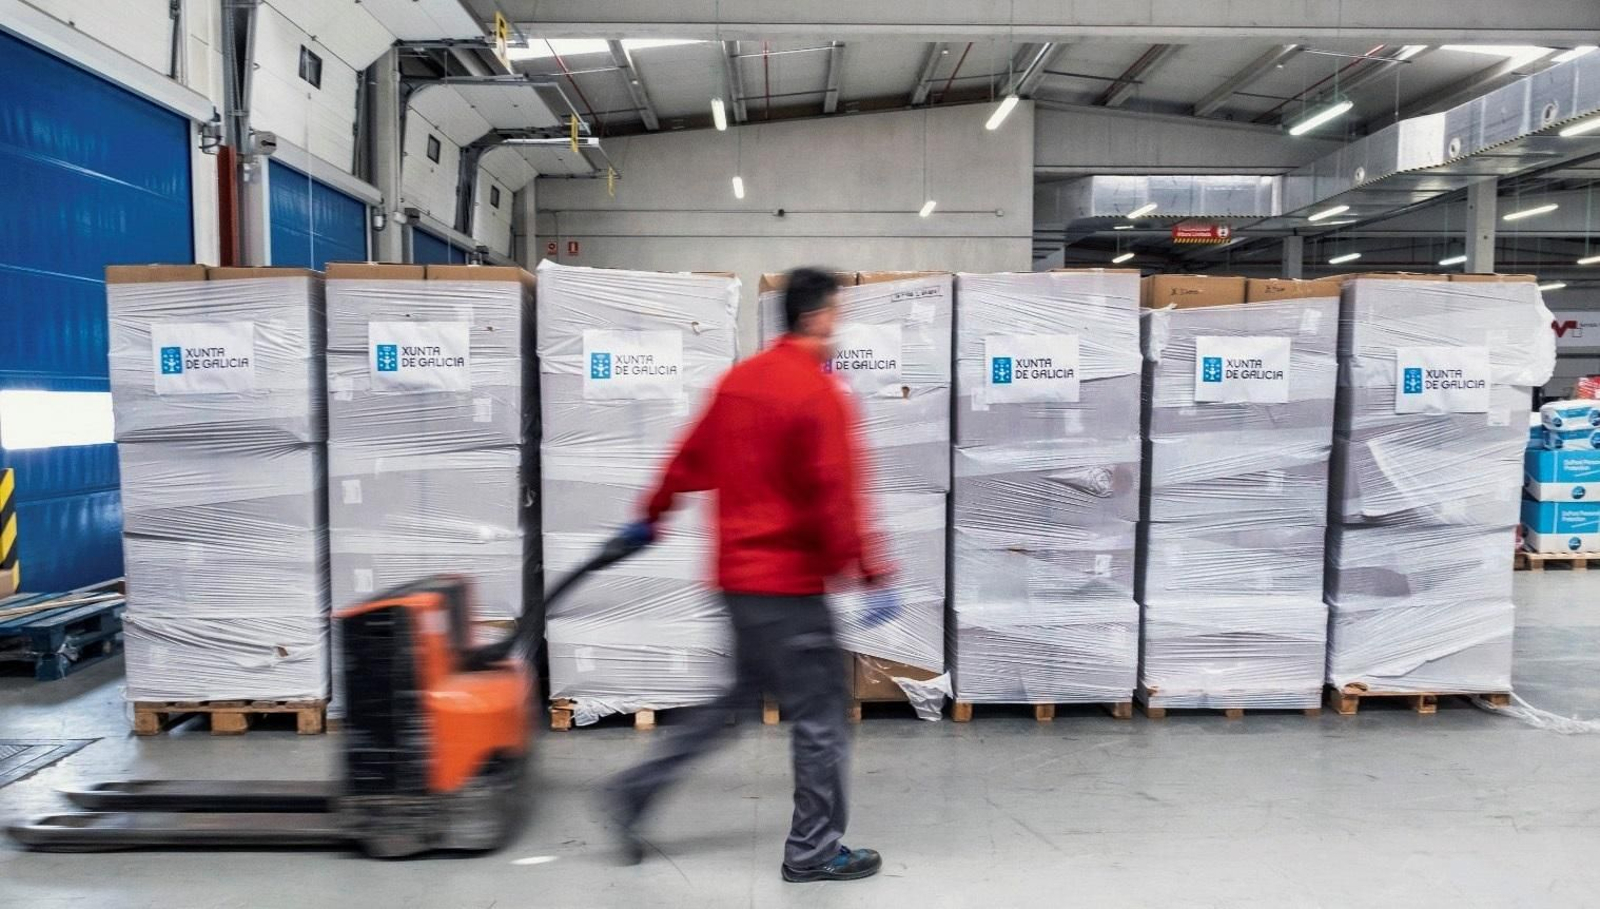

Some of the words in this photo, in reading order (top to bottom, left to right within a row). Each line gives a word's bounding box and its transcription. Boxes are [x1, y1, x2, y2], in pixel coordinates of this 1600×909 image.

[185, 347, 225, 358] XUNTA
[401, 346, 441, 356] XUNTA
[836, 349, 873, 359] XUNTA
[185, 359, 200, 369] DE
[202, 358, 249, 369] GALICIA
[402, 358, 416, 368] DE
[418, 357, 465, 367] GALICIA
[615, 354, 654, 364] XUNTA
[1015, 358, 1052, 368] XUNTA
[1226, 359, 1262, 368] XUNTA
[615, 365, 629, 375] DE
[632, 365, 678, 375] GALICIA
[836, 361, 850, 370] DE
[852, 360, 896, 370] GALICIA
[1015, 370, 1029, 379] DE
[1031, 369, 1075, 379] GALICIA
[1225, 369, 1239, 379] DE
[1241, 370, 1284, 380] GALICIA
[1426, 369, 1462, 379] XUNTA
[1424, 380, 1439, 390] DE
[1441, 380, 1485, 390] GALICIA
